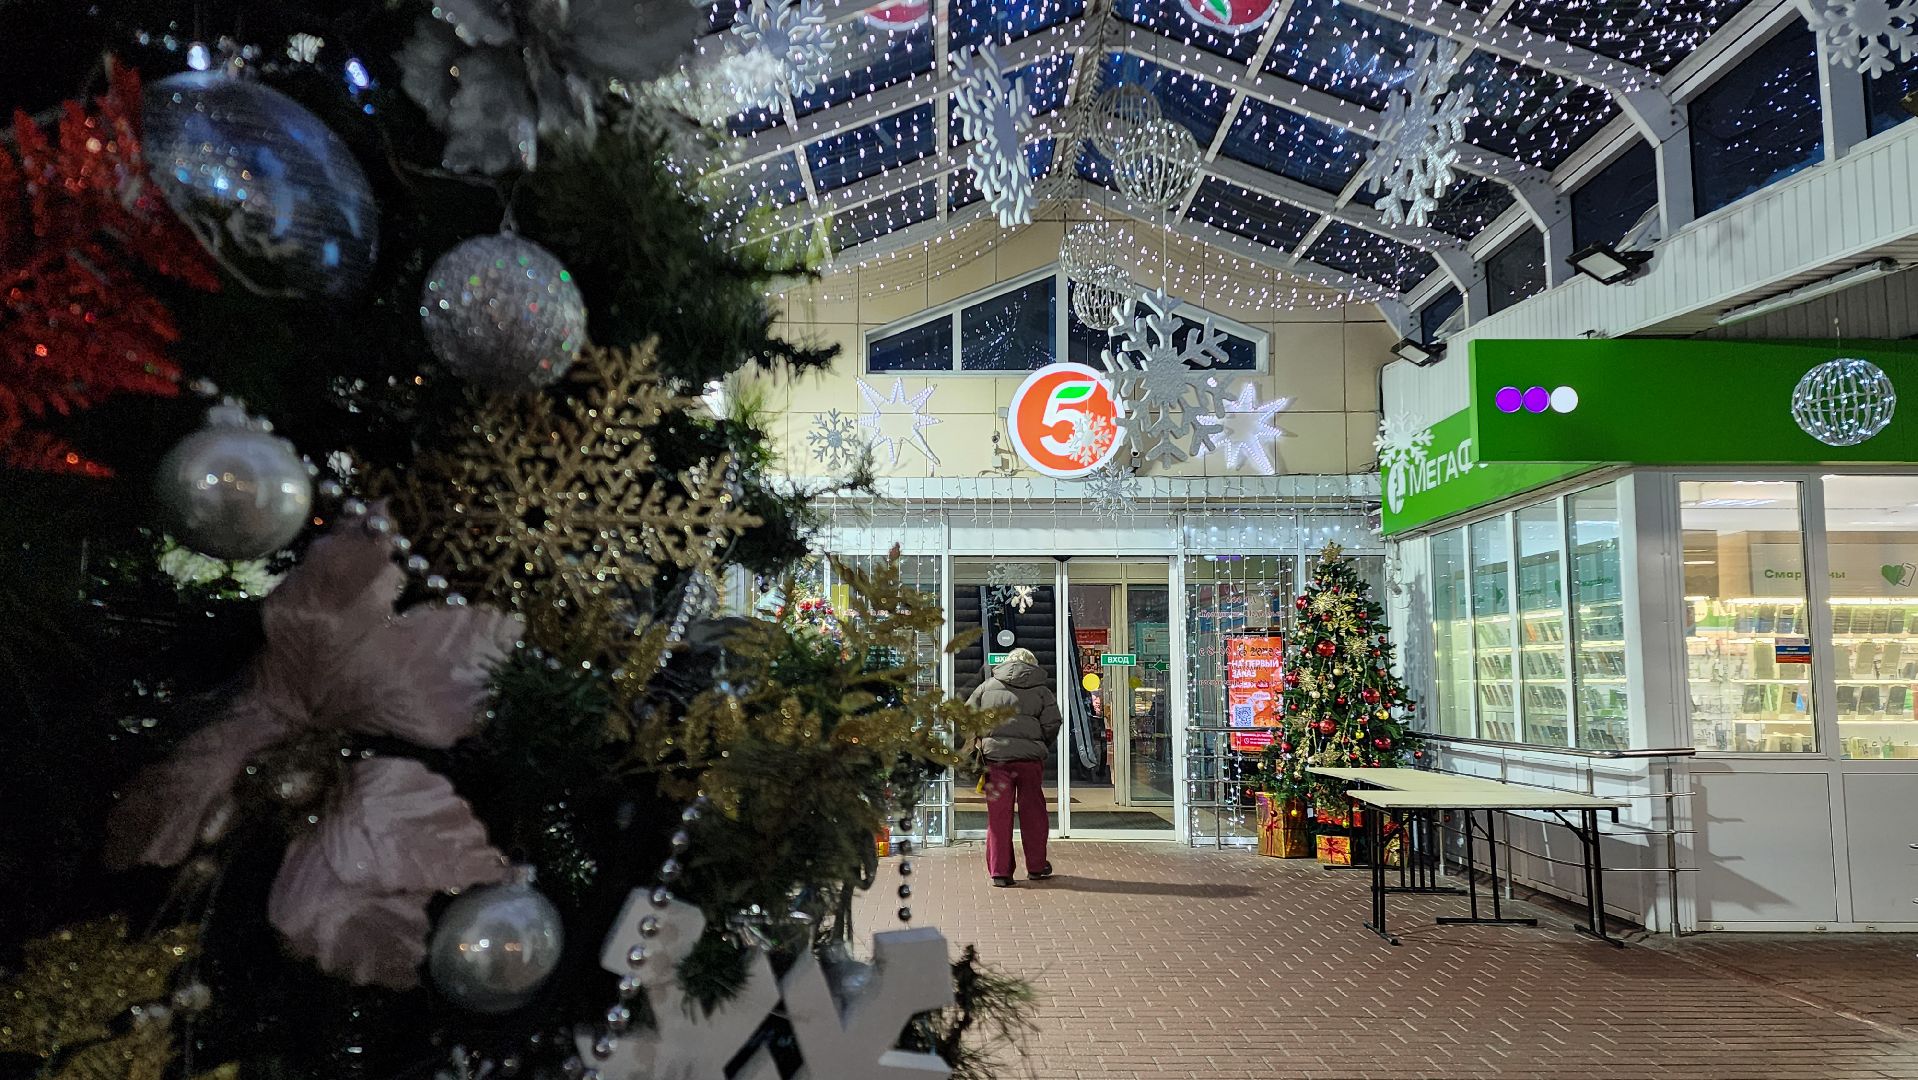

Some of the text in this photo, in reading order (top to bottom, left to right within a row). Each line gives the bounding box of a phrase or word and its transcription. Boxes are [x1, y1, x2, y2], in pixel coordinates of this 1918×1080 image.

[1040, 381, 1098, 456] 5
[1107, 656, 1130, 665] ВХОД
[1246, 657, 1280, 668] ПЕРВЫЙ
[1231, 669, 1257, 678] ЗАКАЗ
